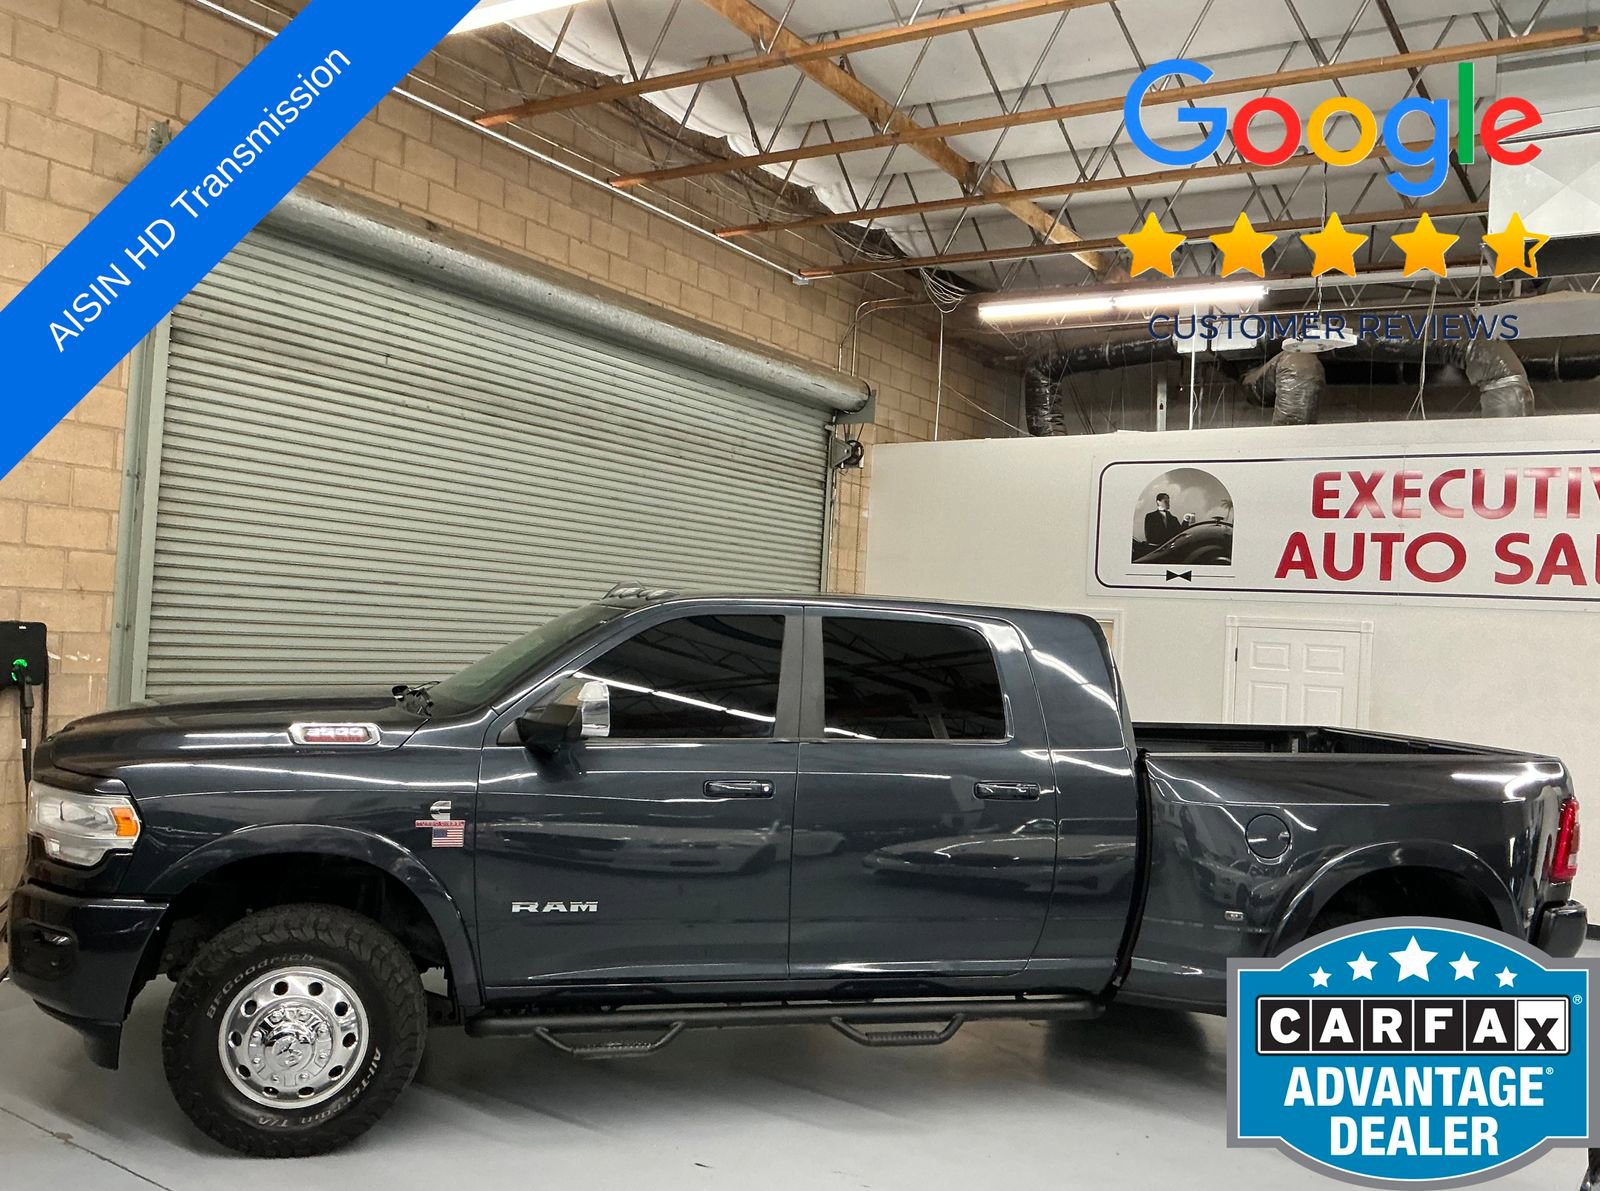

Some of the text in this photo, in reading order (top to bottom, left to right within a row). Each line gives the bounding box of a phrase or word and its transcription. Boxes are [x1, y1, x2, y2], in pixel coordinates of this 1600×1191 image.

[1311, 466, 1600, 519] EXECUTI
[1275, 531, 1467, 583] AUTO
[511, 901, 599, 913] RAM
[206, 953, 315, 1019] BFGoodrich
